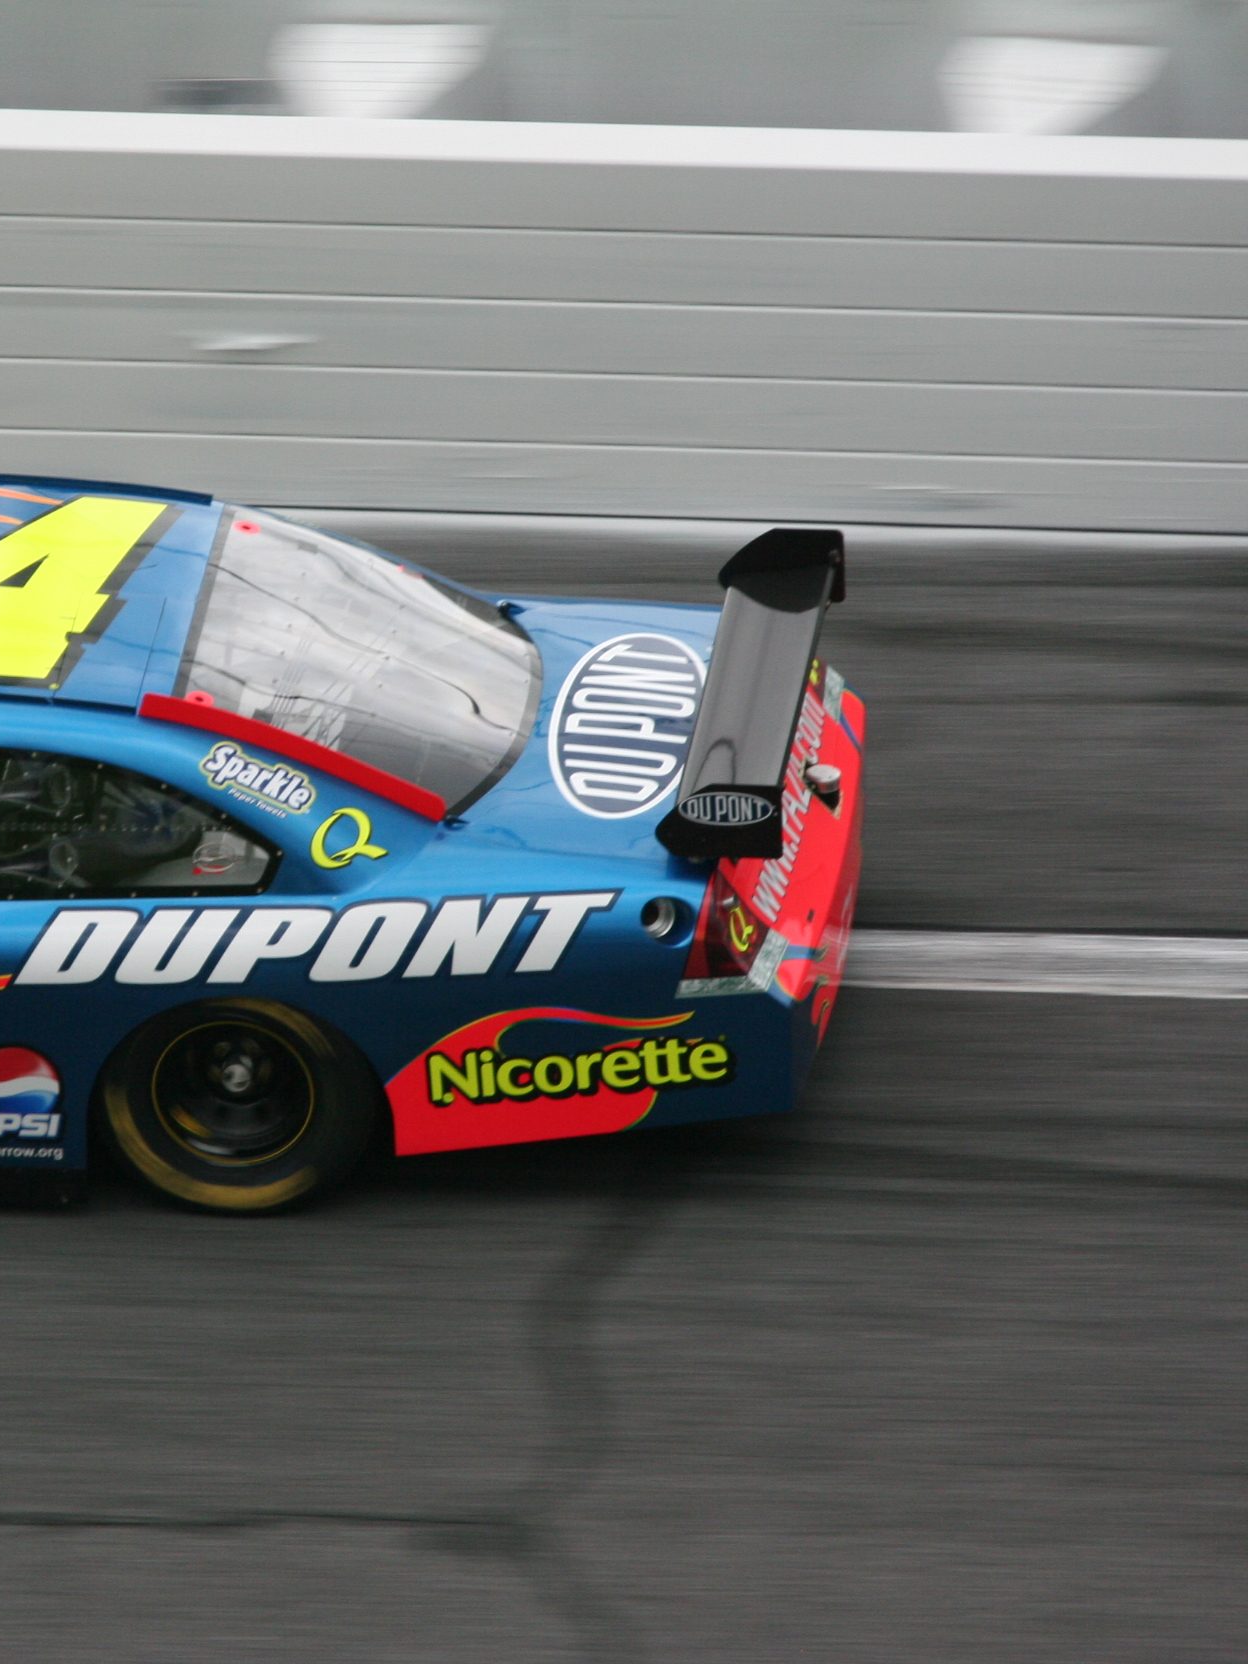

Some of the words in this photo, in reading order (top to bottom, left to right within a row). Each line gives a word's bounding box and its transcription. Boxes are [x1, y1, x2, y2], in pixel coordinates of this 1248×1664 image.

[203, 743, 313, 811] Sparkle
[310, 807, 389, 869] Q
[13, 892, 618, 985] DUPONT
[429, 1039, 729, 1104] Nicorette
